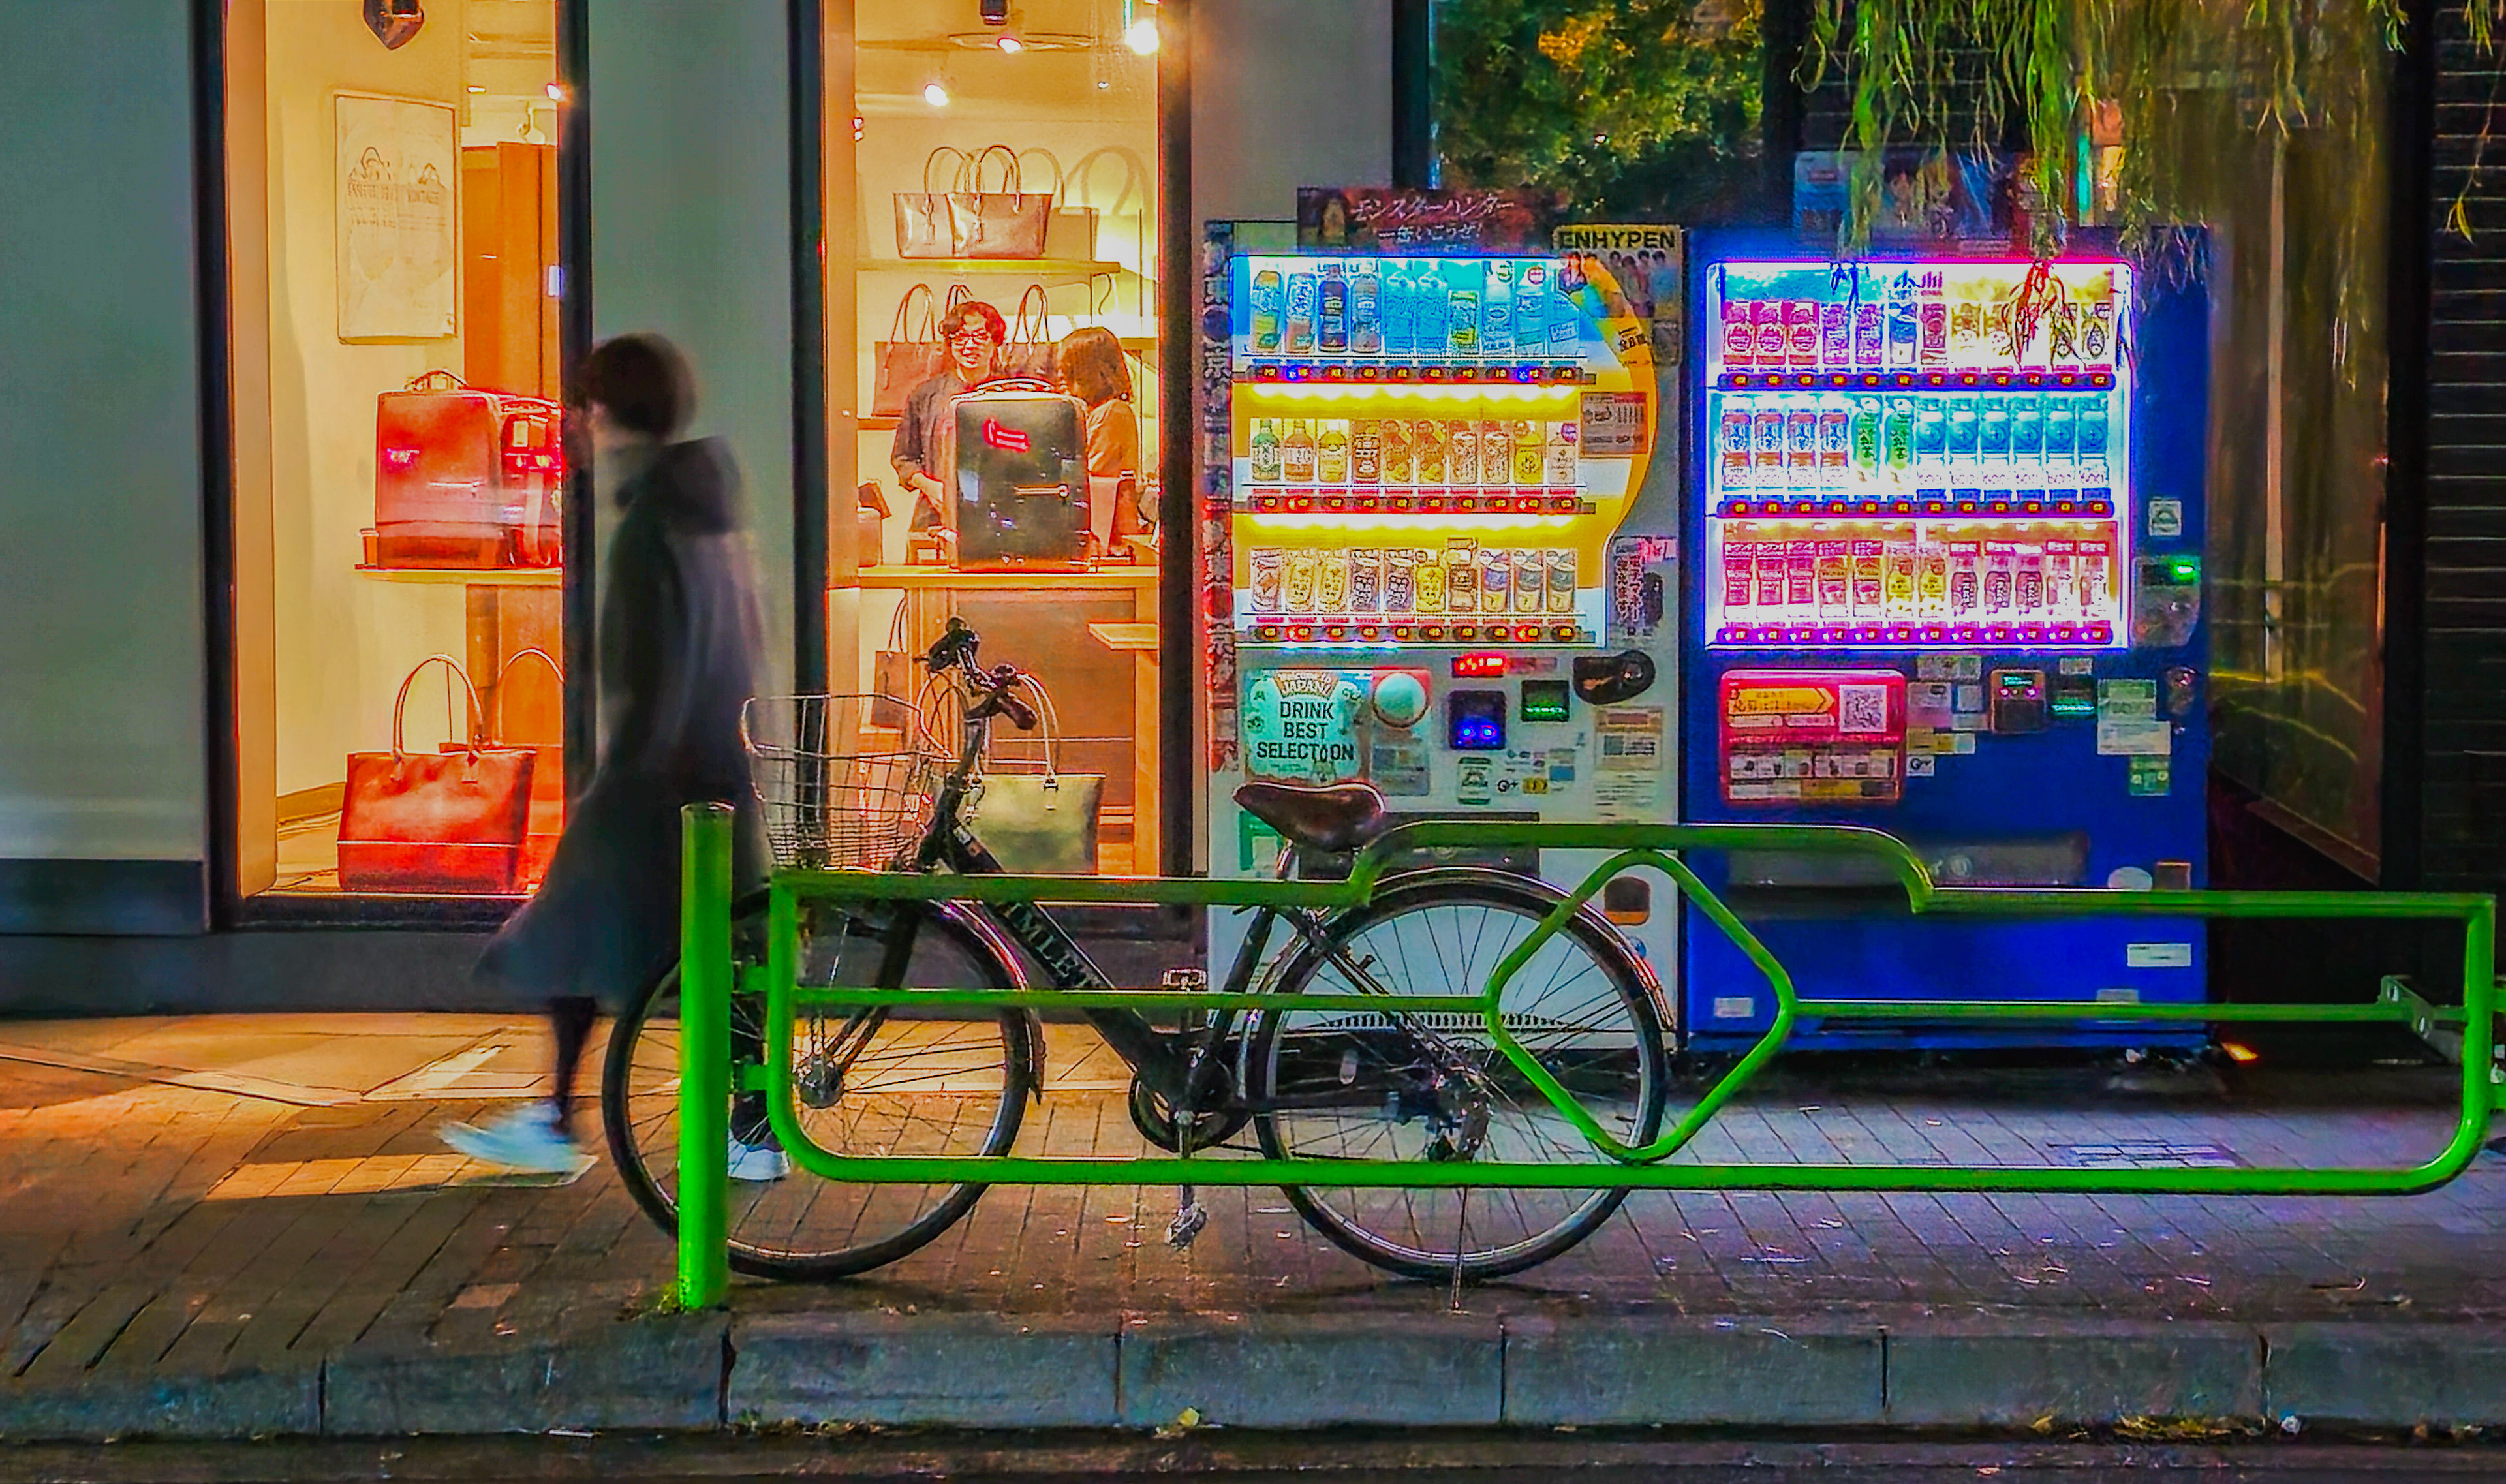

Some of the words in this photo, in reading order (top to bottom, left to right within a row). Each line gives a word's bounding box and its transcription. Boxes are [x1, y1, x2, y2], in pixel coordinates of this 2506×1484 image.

[1560, 230, 1675, 249] ENHYPEN
[1280, 701, 1335, 720] DRINK
[1283, 721, 1329, 739] BEST
